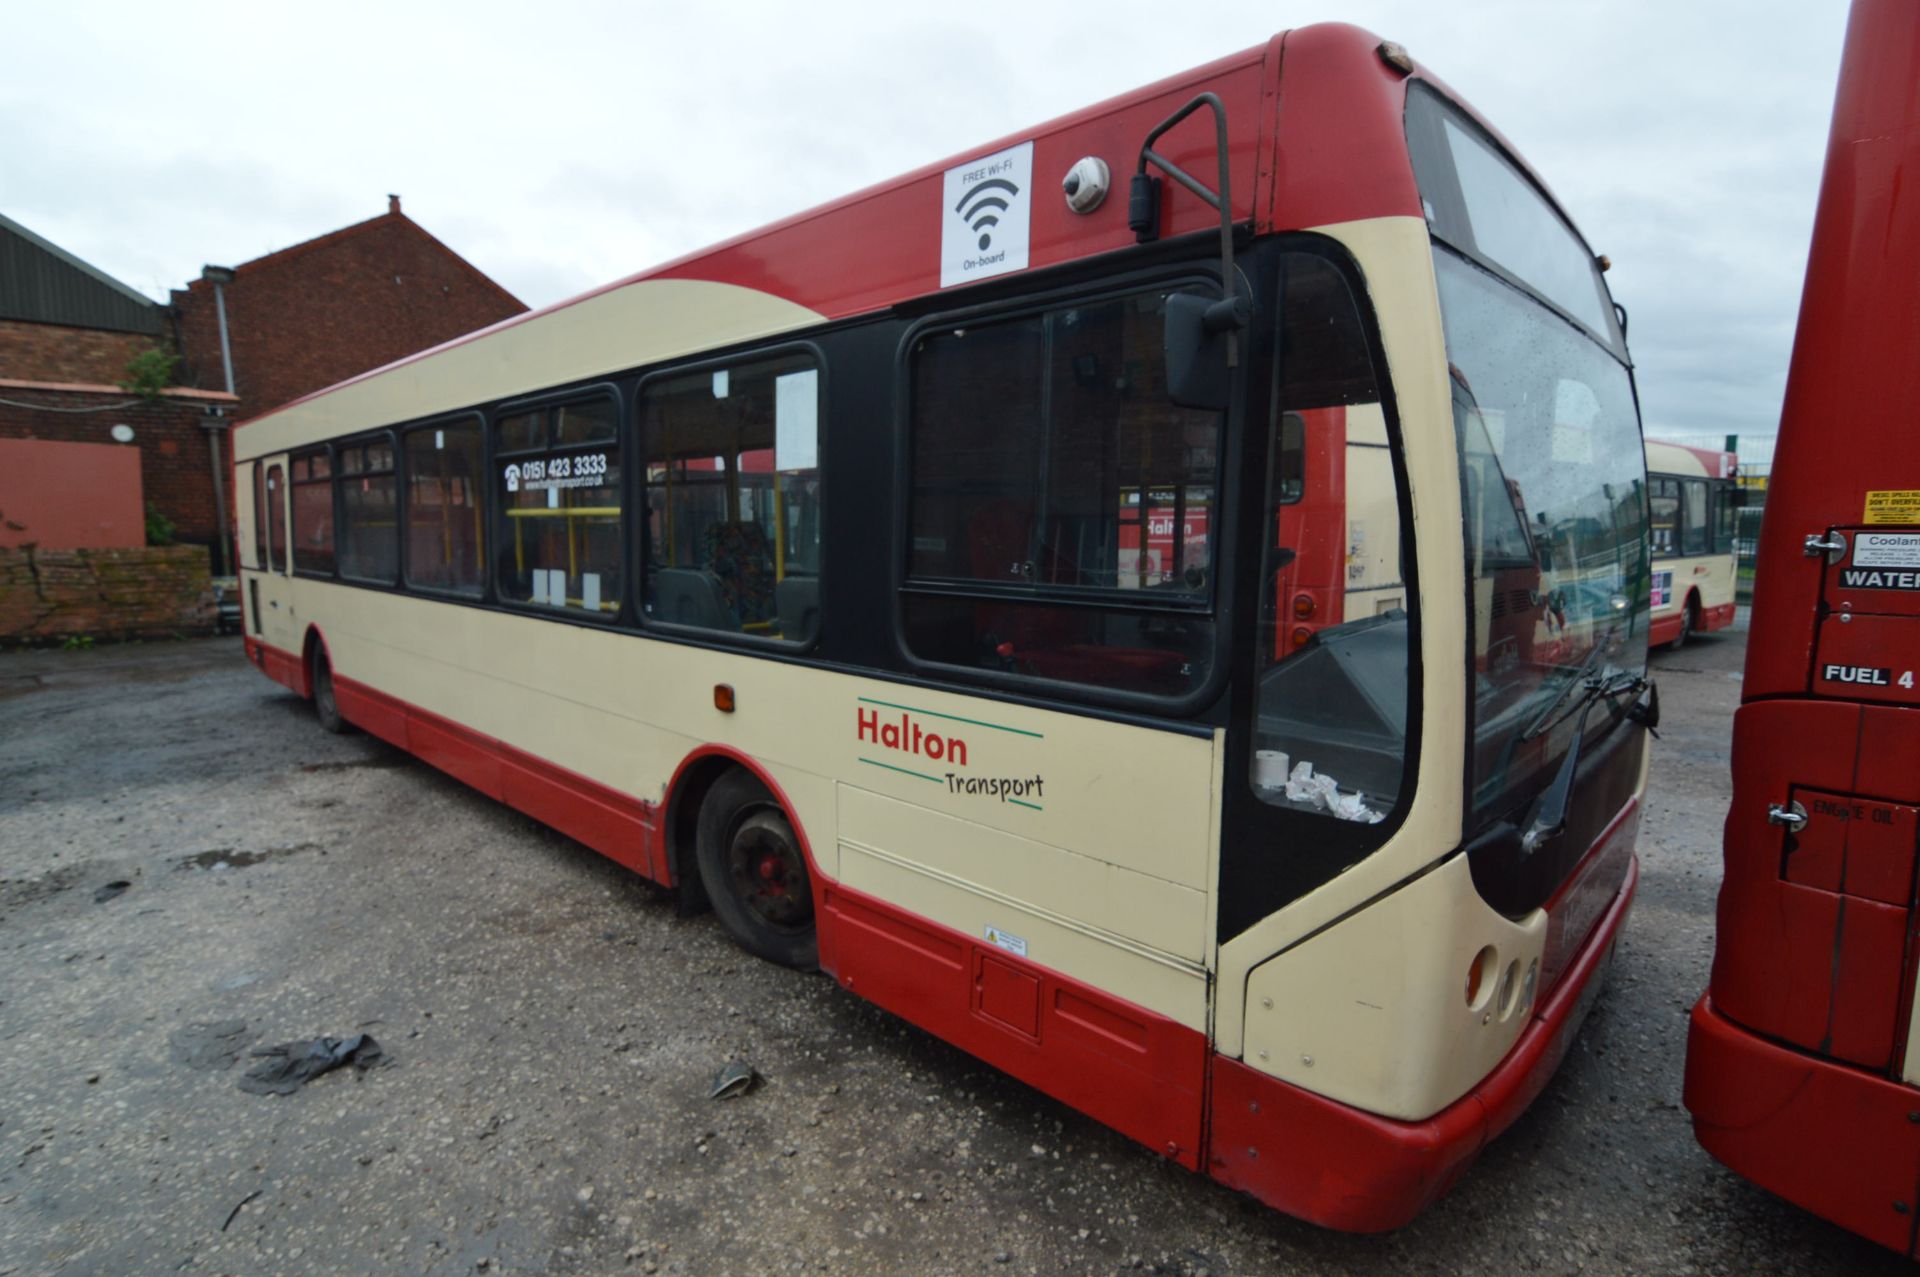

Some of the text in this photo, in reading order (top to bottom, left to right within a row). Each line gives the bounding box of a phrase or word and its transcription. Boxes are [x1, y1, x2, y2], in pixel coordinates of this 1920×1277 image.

[962, 158, 1013, 185] FREE Wi-Fi
[963, 251, 1005, 271] On-board
[523, 454, 607, 480] 0151 423 3333
[1825, 664, 1914, 688] FUEL 4
[858, 707, 967, 766] Halton
[945, 773, 1044, 803] Transport
[1871, 806, 1894, 825] OIL
